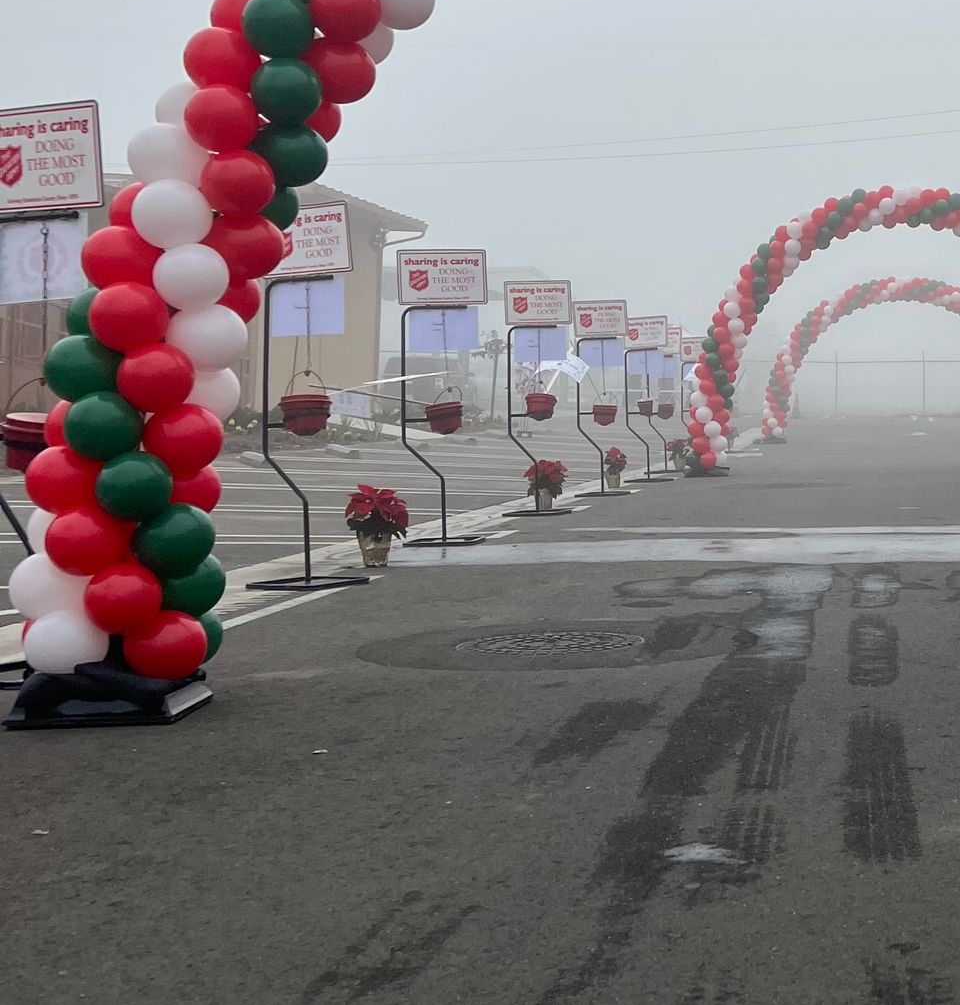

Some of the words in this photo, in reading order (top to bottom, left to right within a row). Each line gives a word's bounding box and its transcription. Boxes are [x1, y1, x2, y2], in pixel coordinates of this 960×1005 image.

[38, 120, 46, 133] is
[50, 117, 88, 134] caring
[35, 138, 75, 153] DOING
[27, 158, 49, 171] THE
[52, 154, 86, 169] MOST
[39, 172, 76, 187] GOOD
[304, 214, 312, 223] is
[314, 212, 342, 223] caring
[303, 225, 332, 237] DOING
[295, 239, 314, 249] THE
[315, 236, 340, 246] MOST
[305, 248, 333, 259] GOOD
[404, 257, 438, 268] sharing
[440, 257, 448, 265] is
[450, 257, 479, 267] caring
[431, 276, 450, 284] THE
[451, 276, 477, 284] MOST
[440, 285, 468, 293] GOOD
[509, 286, 535, 295] sharing
[536, 285, 542, 293] is
[543, 285, 566, 294] caring
